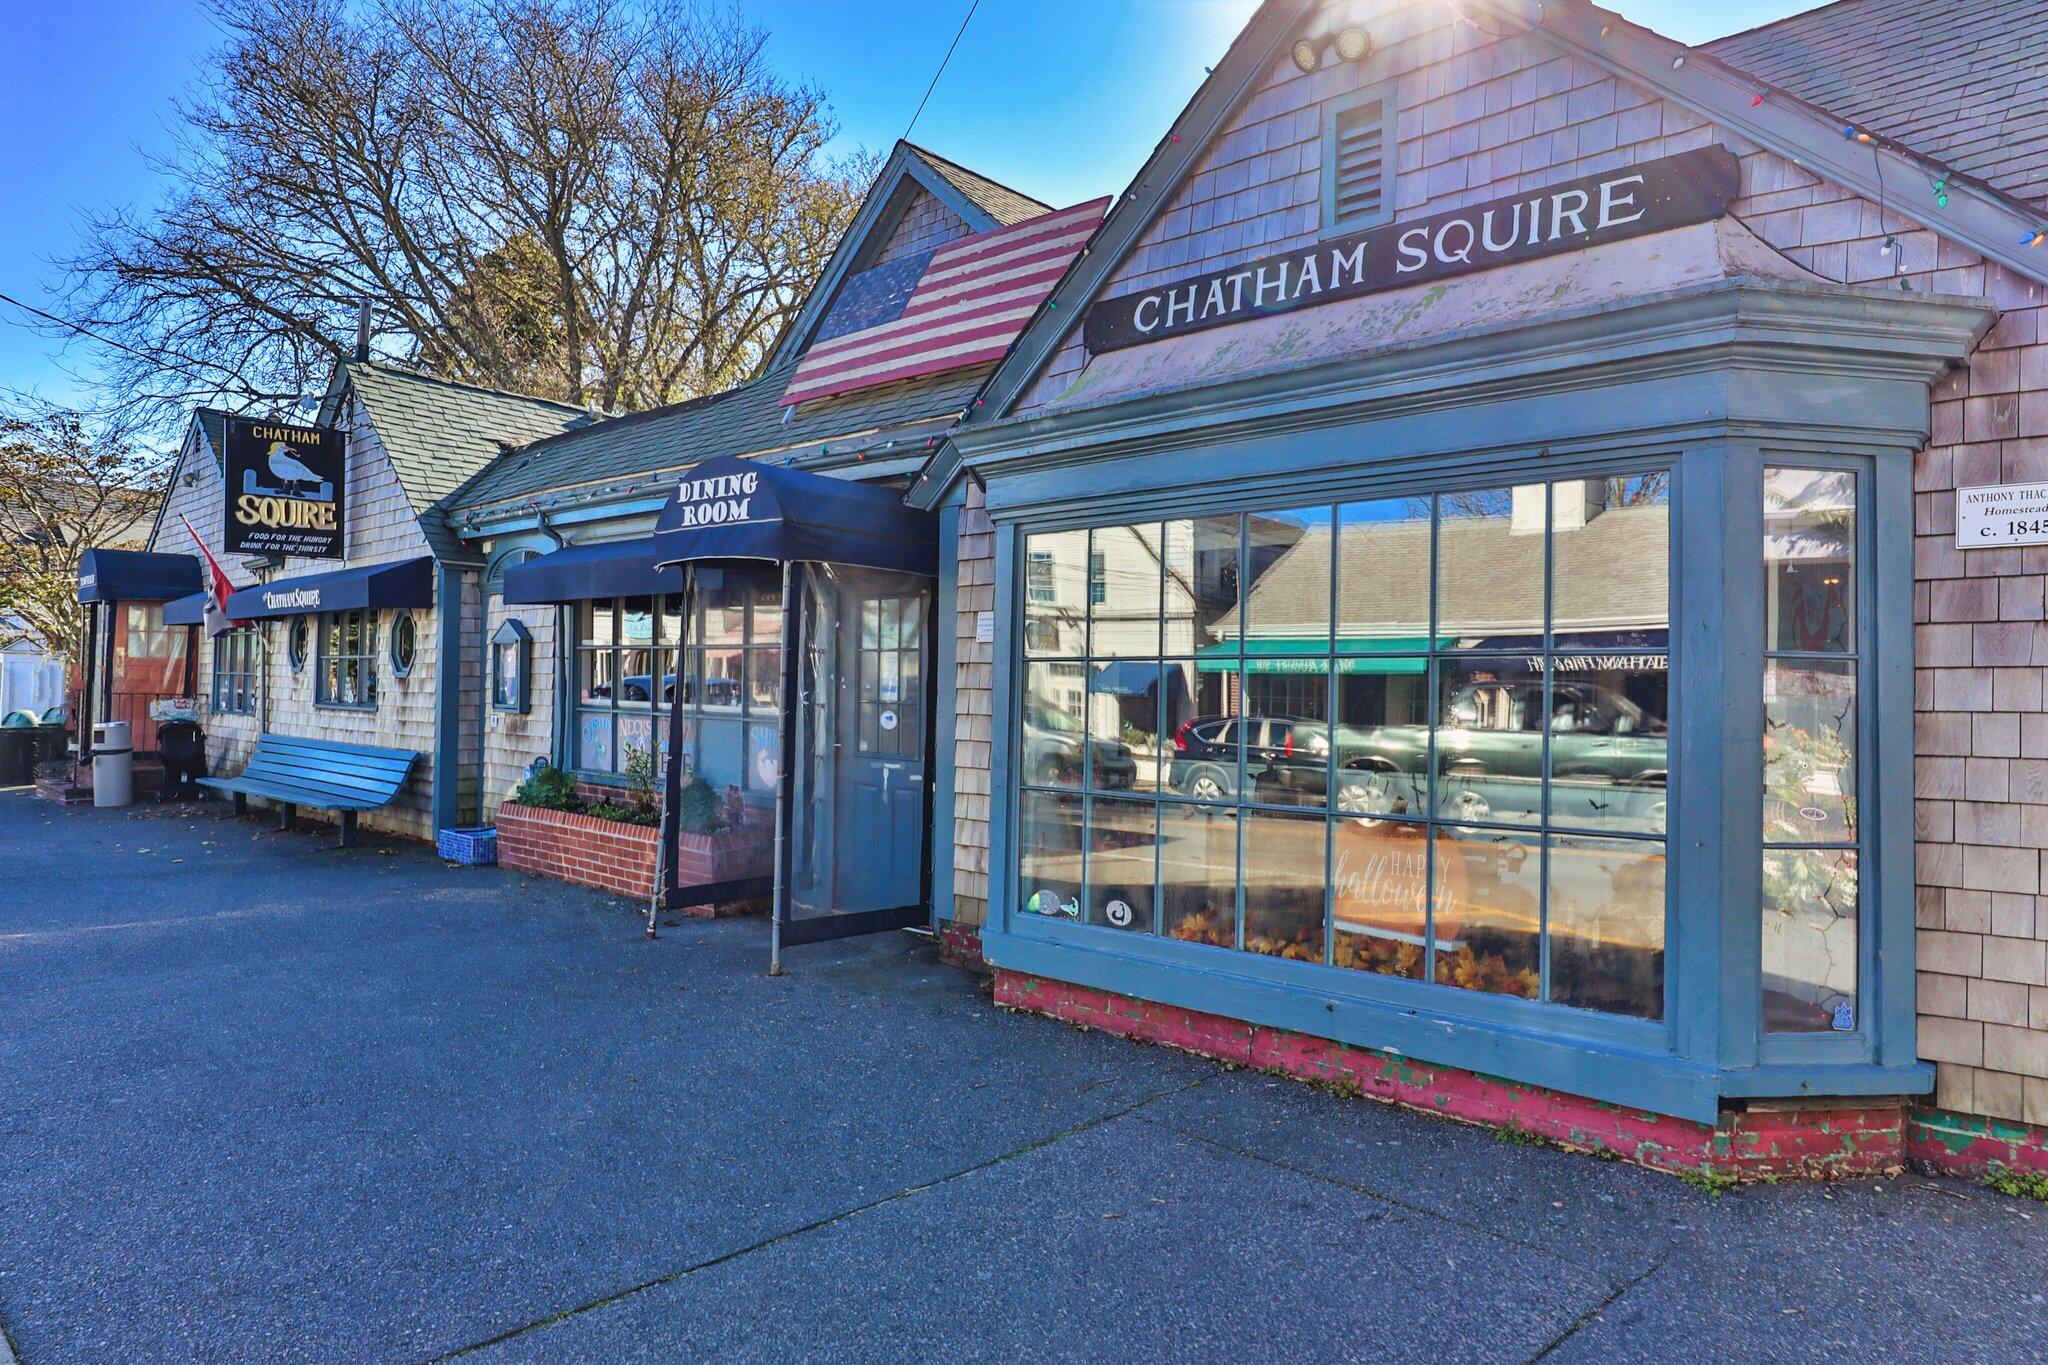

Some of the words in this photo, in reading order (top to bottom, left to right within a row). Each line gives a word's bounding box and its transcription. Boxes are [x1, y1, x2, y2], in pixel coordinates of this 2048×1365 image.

[1133, 241, 1368, 333] CHATHAM
[1396, 174, 1646, 274] SQUIRE
[253, 426, 320, 445] CHATHAM
[677, 471, 759, 503] DINING
[1966, 491, 2015, 504] ANTHONY
[2019, 489, 2048, 501] THAC
[235, 495, 337, 530] SQUIRE
[681, 498, 751, 526] ROOM
[1980, 527, 1997, 537] c.
[2006, 520, 2048, 536] 1845
[239, 541, 264, 550] DRINK
[265, 542, 281, 551] FOR
[282, 544, 297, 552] THE
[297, 544, 328, 554] THIRSTY
[248, 532, 270, 540] FOOD
[270, 533, 287, 542] FOR
[288, 534, 303, 543] THE
[303, 535, 333, 545] HUNGRY
[620, 718, 651, 737] NECKS
[1390, 850, 1452, 883] HAPY
